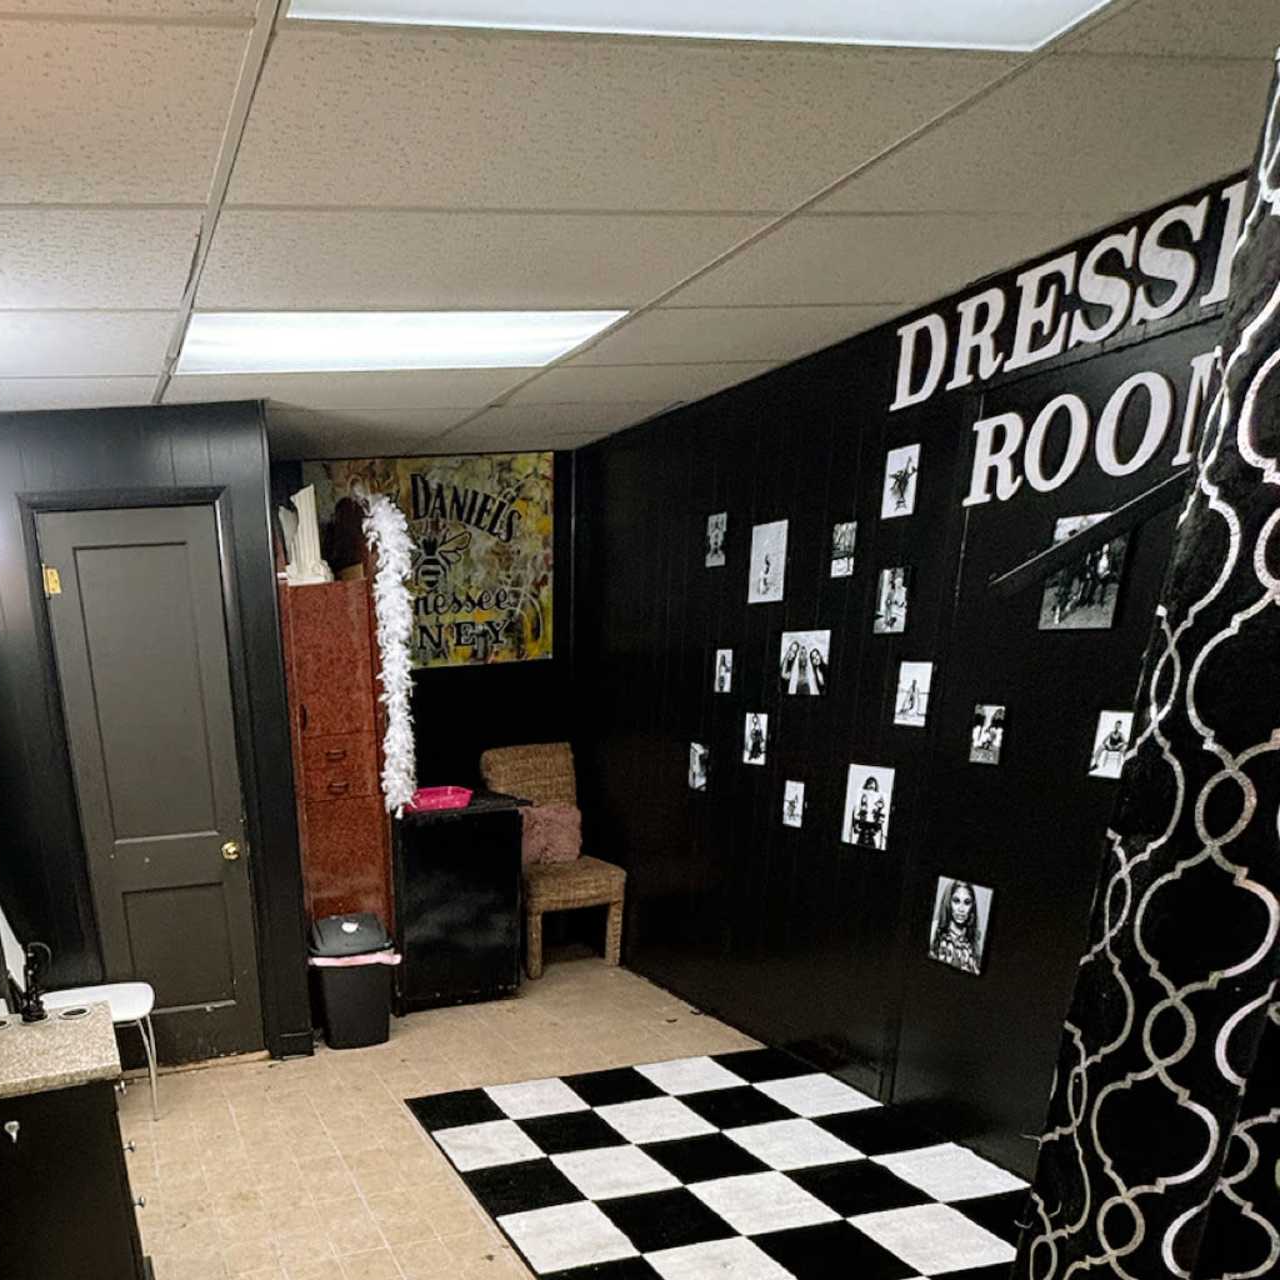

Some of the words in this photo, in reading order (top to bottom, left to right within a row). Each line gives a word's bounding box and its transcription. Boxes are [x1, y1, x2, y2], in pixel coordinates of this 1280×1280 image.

[890, 181, 1247, 412] DRESSI
[410, 474, 521, 542] DANIELS
[416, 619, 511, 651] NEY
